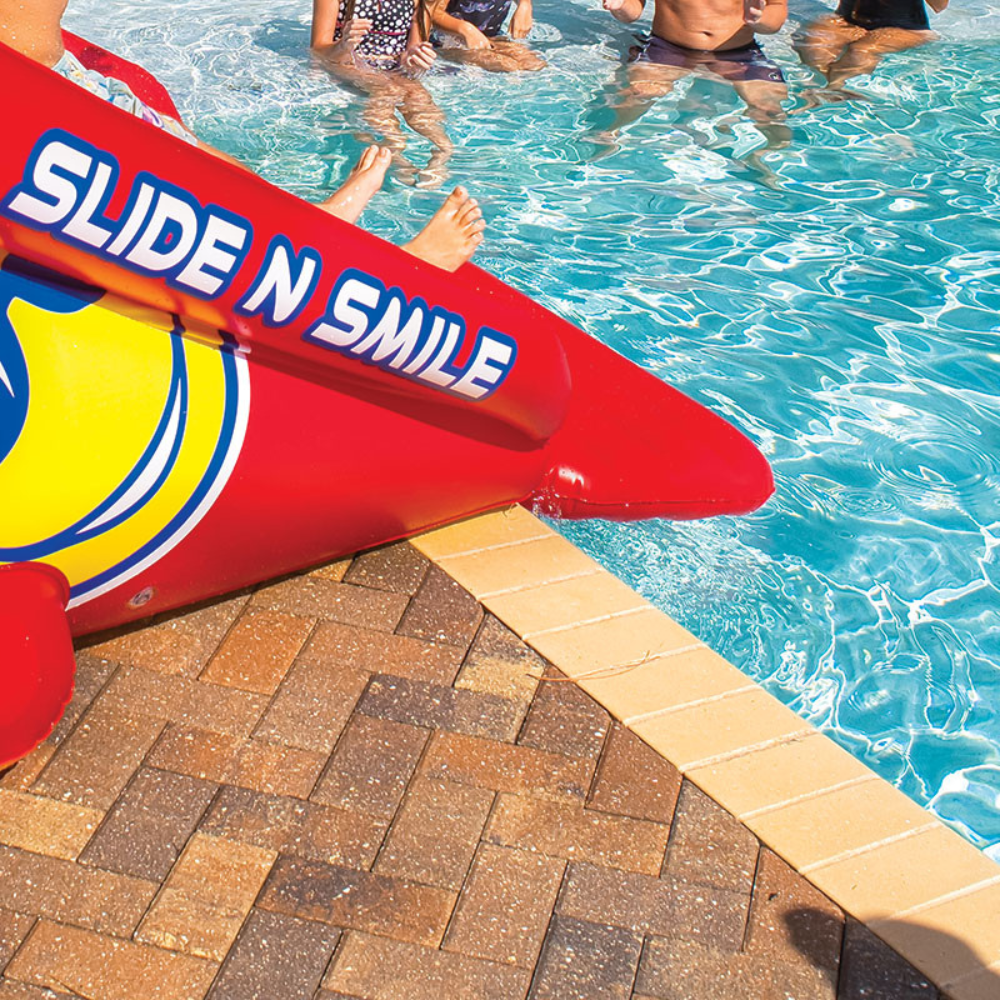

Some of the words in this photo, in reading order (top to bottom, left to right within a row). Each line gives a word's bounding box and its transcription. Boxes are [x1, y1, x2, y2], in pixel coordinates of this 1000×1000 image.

[5, 137, 249, 297] SLIDE
[240, 240, 319, 324] N
[308, 274, 515, 400] SMILE
